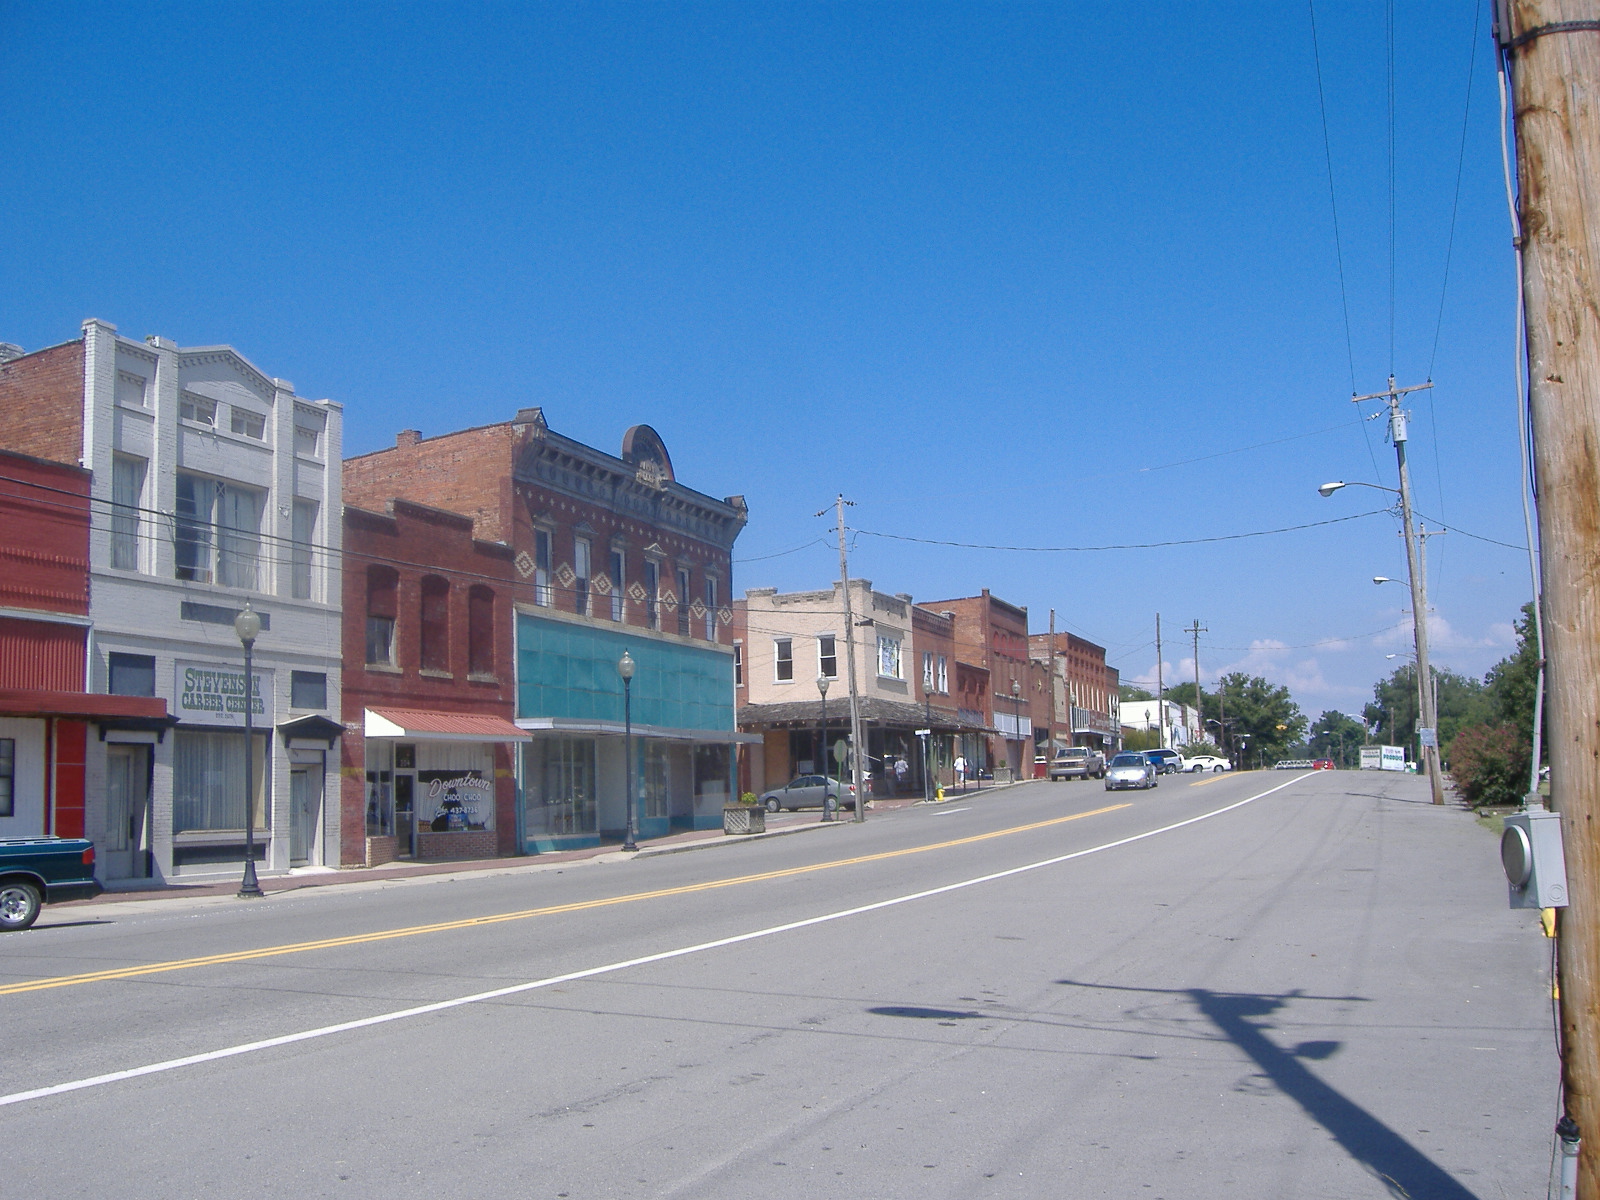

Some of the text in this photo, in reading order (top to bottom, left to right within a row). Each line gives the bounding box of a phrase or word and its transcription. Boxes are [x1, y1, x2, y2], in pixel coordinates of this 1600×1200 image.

[185, 667, 260, 696] STEVENSN
[182, 692, 264, 714] CAREER CENER
[429, 771, 491, 797] Downtown
[443, 793, 481, 802] CHOO CHOO
